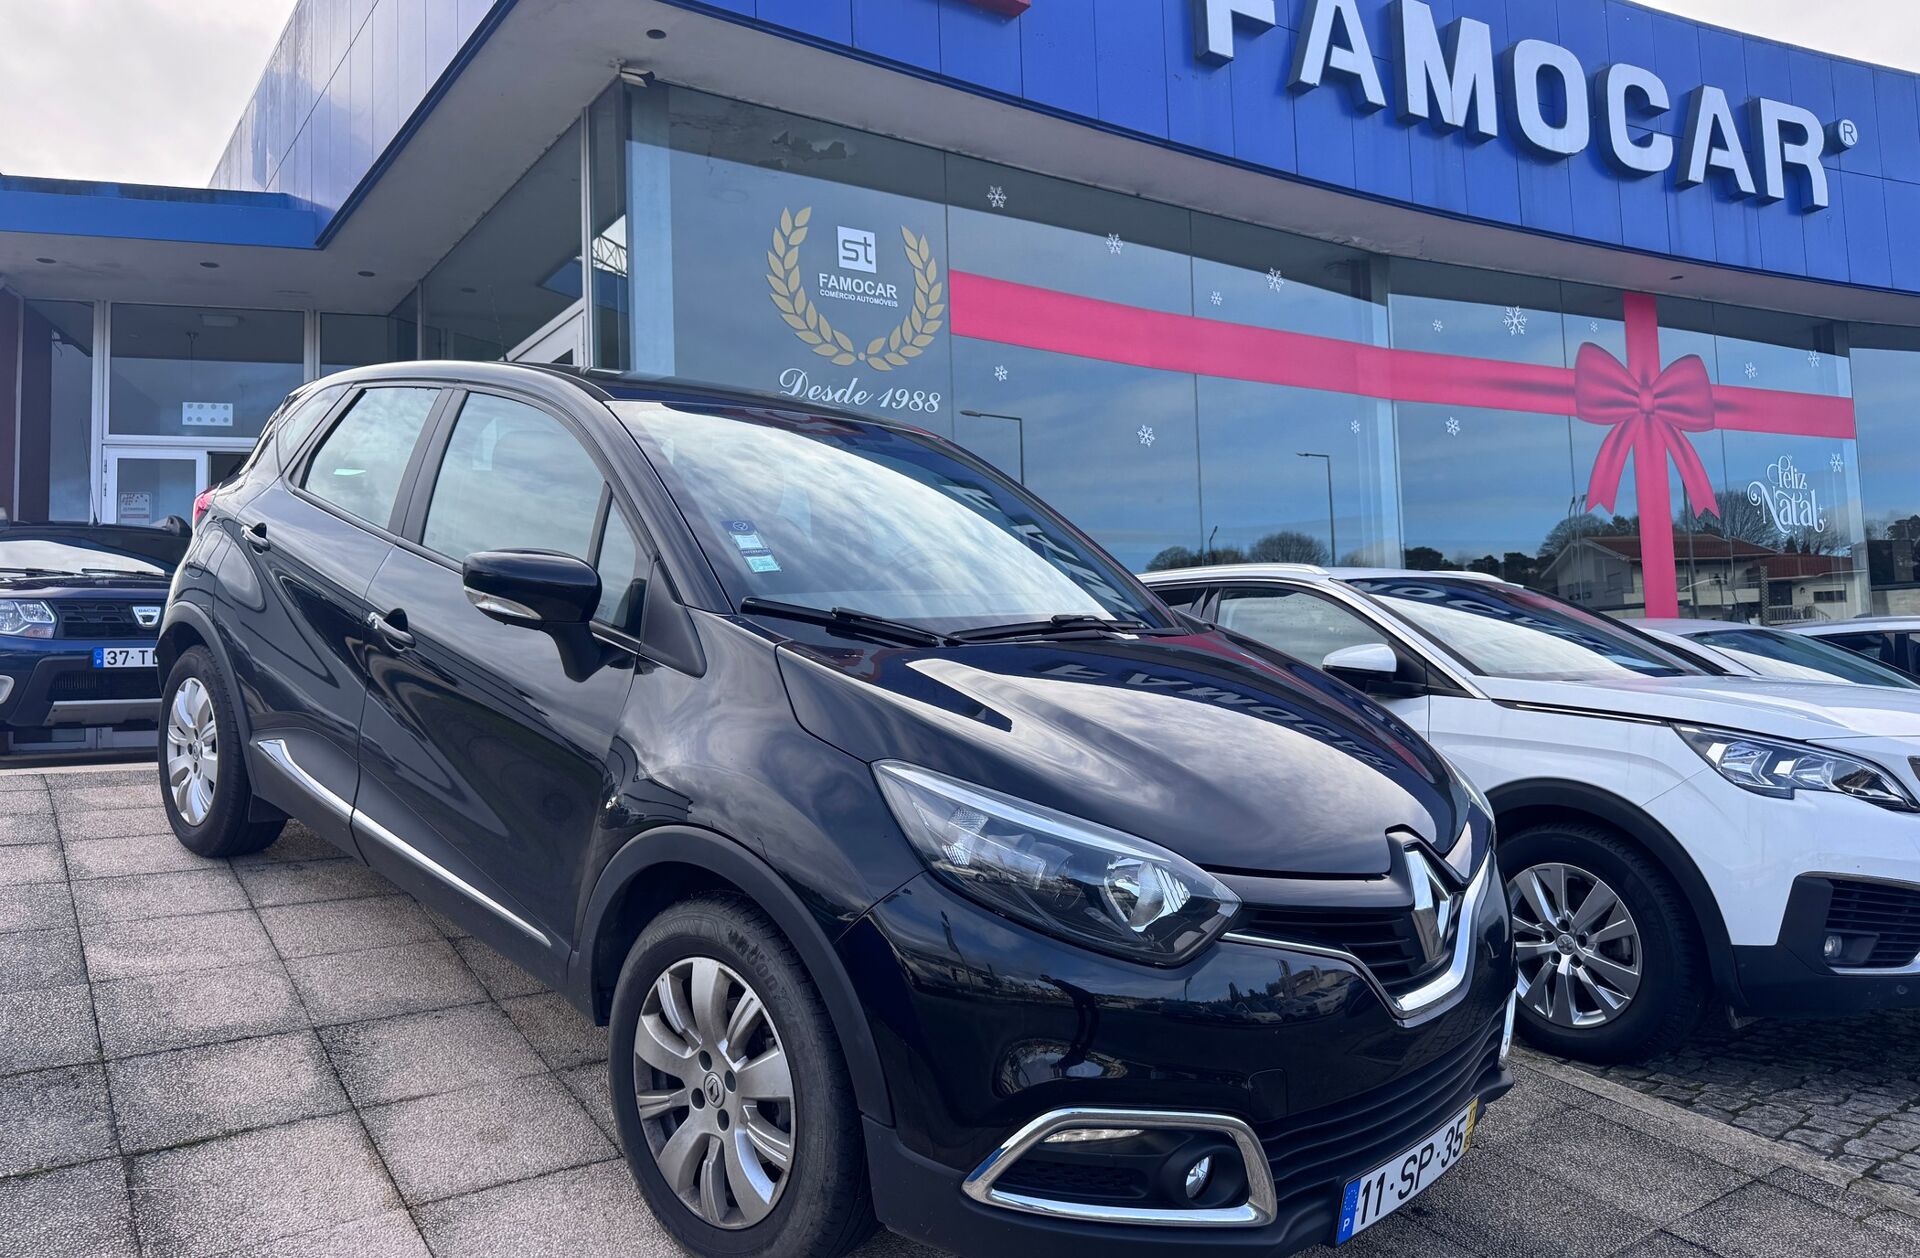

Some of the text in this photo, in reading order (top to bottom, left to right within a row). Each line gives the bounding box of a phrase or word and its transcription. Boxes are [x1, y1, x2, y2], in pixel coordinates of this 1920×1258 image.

[818, 273, 898, 299] FAMOCAR
[819, 288, 899, 308] COMÉRCIO AUTOMÓVEIS
[779, 367, 941, 413] Desde 1988
[1747, 481, 1825, 533] Natal
